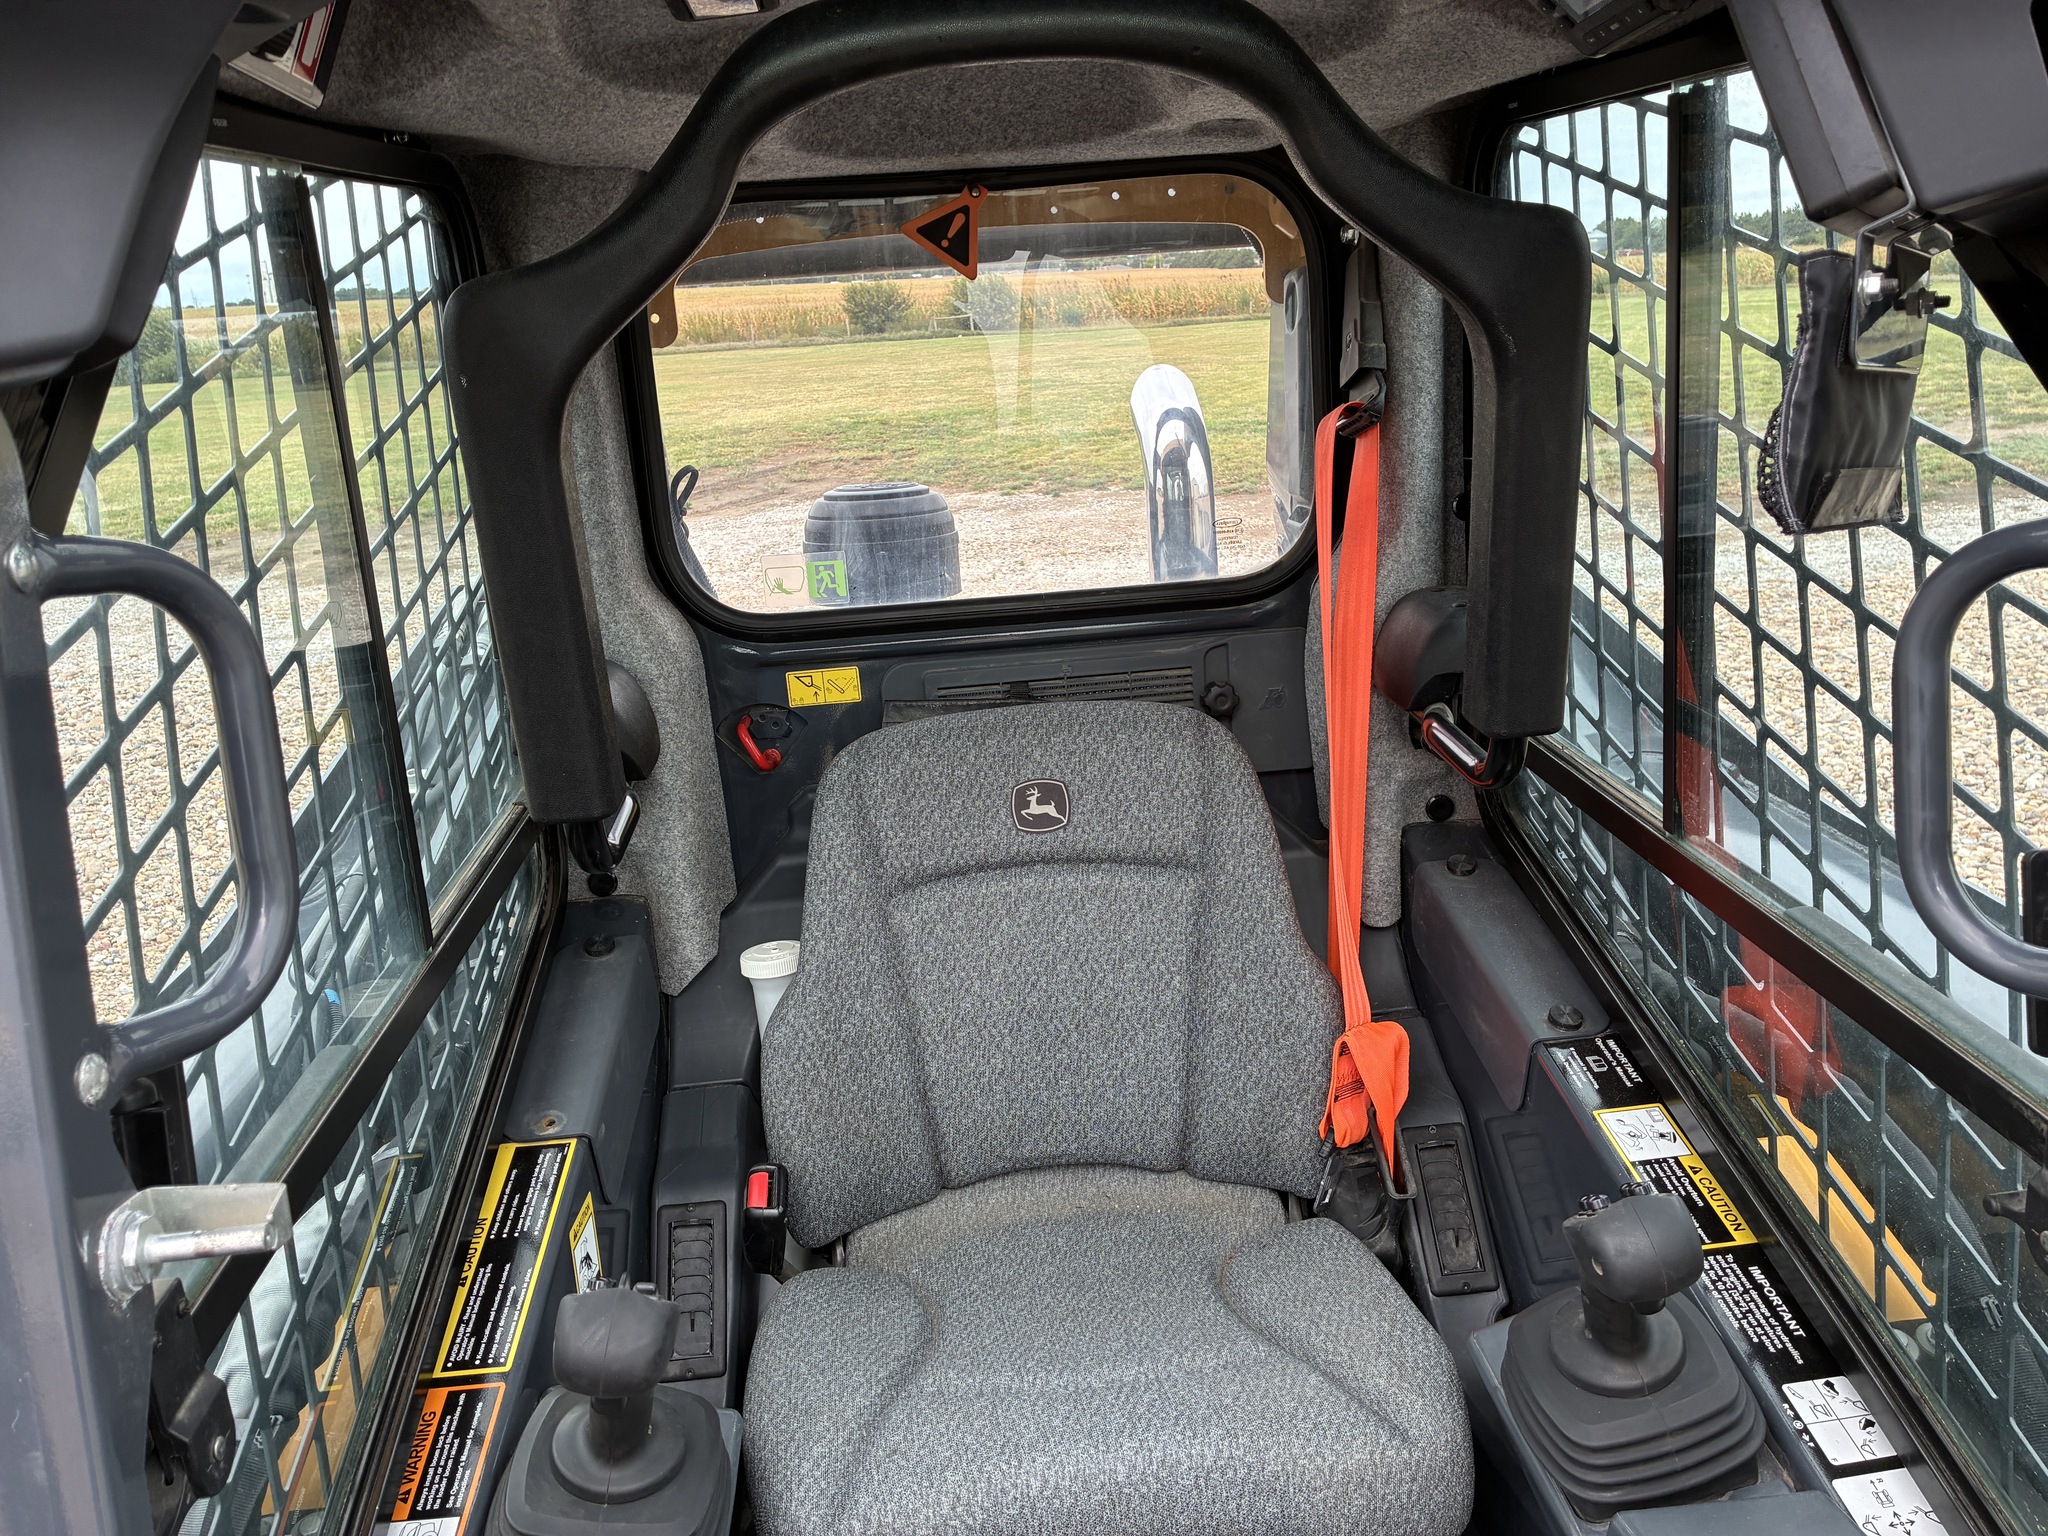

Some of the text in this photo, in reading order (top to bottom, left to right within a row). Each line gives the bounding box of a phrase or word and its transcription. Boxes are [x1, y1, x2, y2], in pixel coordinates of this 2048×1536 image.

[1592, 1037, 1633, 1087] Operator's Manual
[1605, 1039, 1643, 1083] IMPORTANT
[1665, 1157, 1706, 1206] Avoid Overturn
[1697, 1177, 1745, 1231] CAUTION
[463, 1217, 488, 1273] CAUTION
[470, 1267, 484, 1295] understand
[499, 1262, 511, 1283] controls.
[523, 1267, 533, 1281] place.
[456, 1263, 492, 1360] Operator's Manual before operating this
[467, 1296, 475, 1305] and
[490, 1289, 502, 1310] function
[514, 1288, 526, 1310] windows
[1706, 1256, 1726, 1275] below
[1744, 1313, 1759, 1325] run
[1759, 1335, 1778, 1352] slow
[1706, 1270, 1719, 1280] for
[1713, 1281, 1725, 1289] 10
[1719, 1290, 1745, 1318] minutes
[1738, 1319, 1761, 1342] before
[1714, 1255, 1729, 1267] and
[1722, 1268, 1747, 1293] engine,
[1746, 1302, 1785, 1348] temperatures
[1723, 1253, 1806, 1364] To prevent damage of hydraulics
[1746, 1266, 1806, 1336] IMPORTANT
[462, 1306, 472, 1319] Read
[487, 1311, 495, 1321] and
[488, 1284, 516, 1357] Keep safety devices working.
[511, 1310, 519, 1320] and
[1715, 1299, 1743, 1329] controls.
[454, 1323, 466, 1343] INJURY
[480, 1321, 492, 1342] location
[505, 1321, 516, 1341] screens
[448, 1343, 460, 1361] AVOID
[475, 1343, 485, 1358] Know
[500, 1342, 511, 1356] Keep
[457, 1392, 466, 1405] with
[449, 1406, 462, 1430] machine
[405, 1411, 436, 1483] WARNING
[445, 1431, 454, 1443] this
[415, 1415, 451, 1510] Always install boom lock before
[438, 1444, 450, 1465] around
[445, 1401, 485, 1507] See Operator's Manual for complete
[432, 1437, 460, 1509] the loader boom raised.
[432, 1474, 440, 1483] on
[424, 1484, 439, 1509] working
[454, 1468, 472, 1507] instructions.
